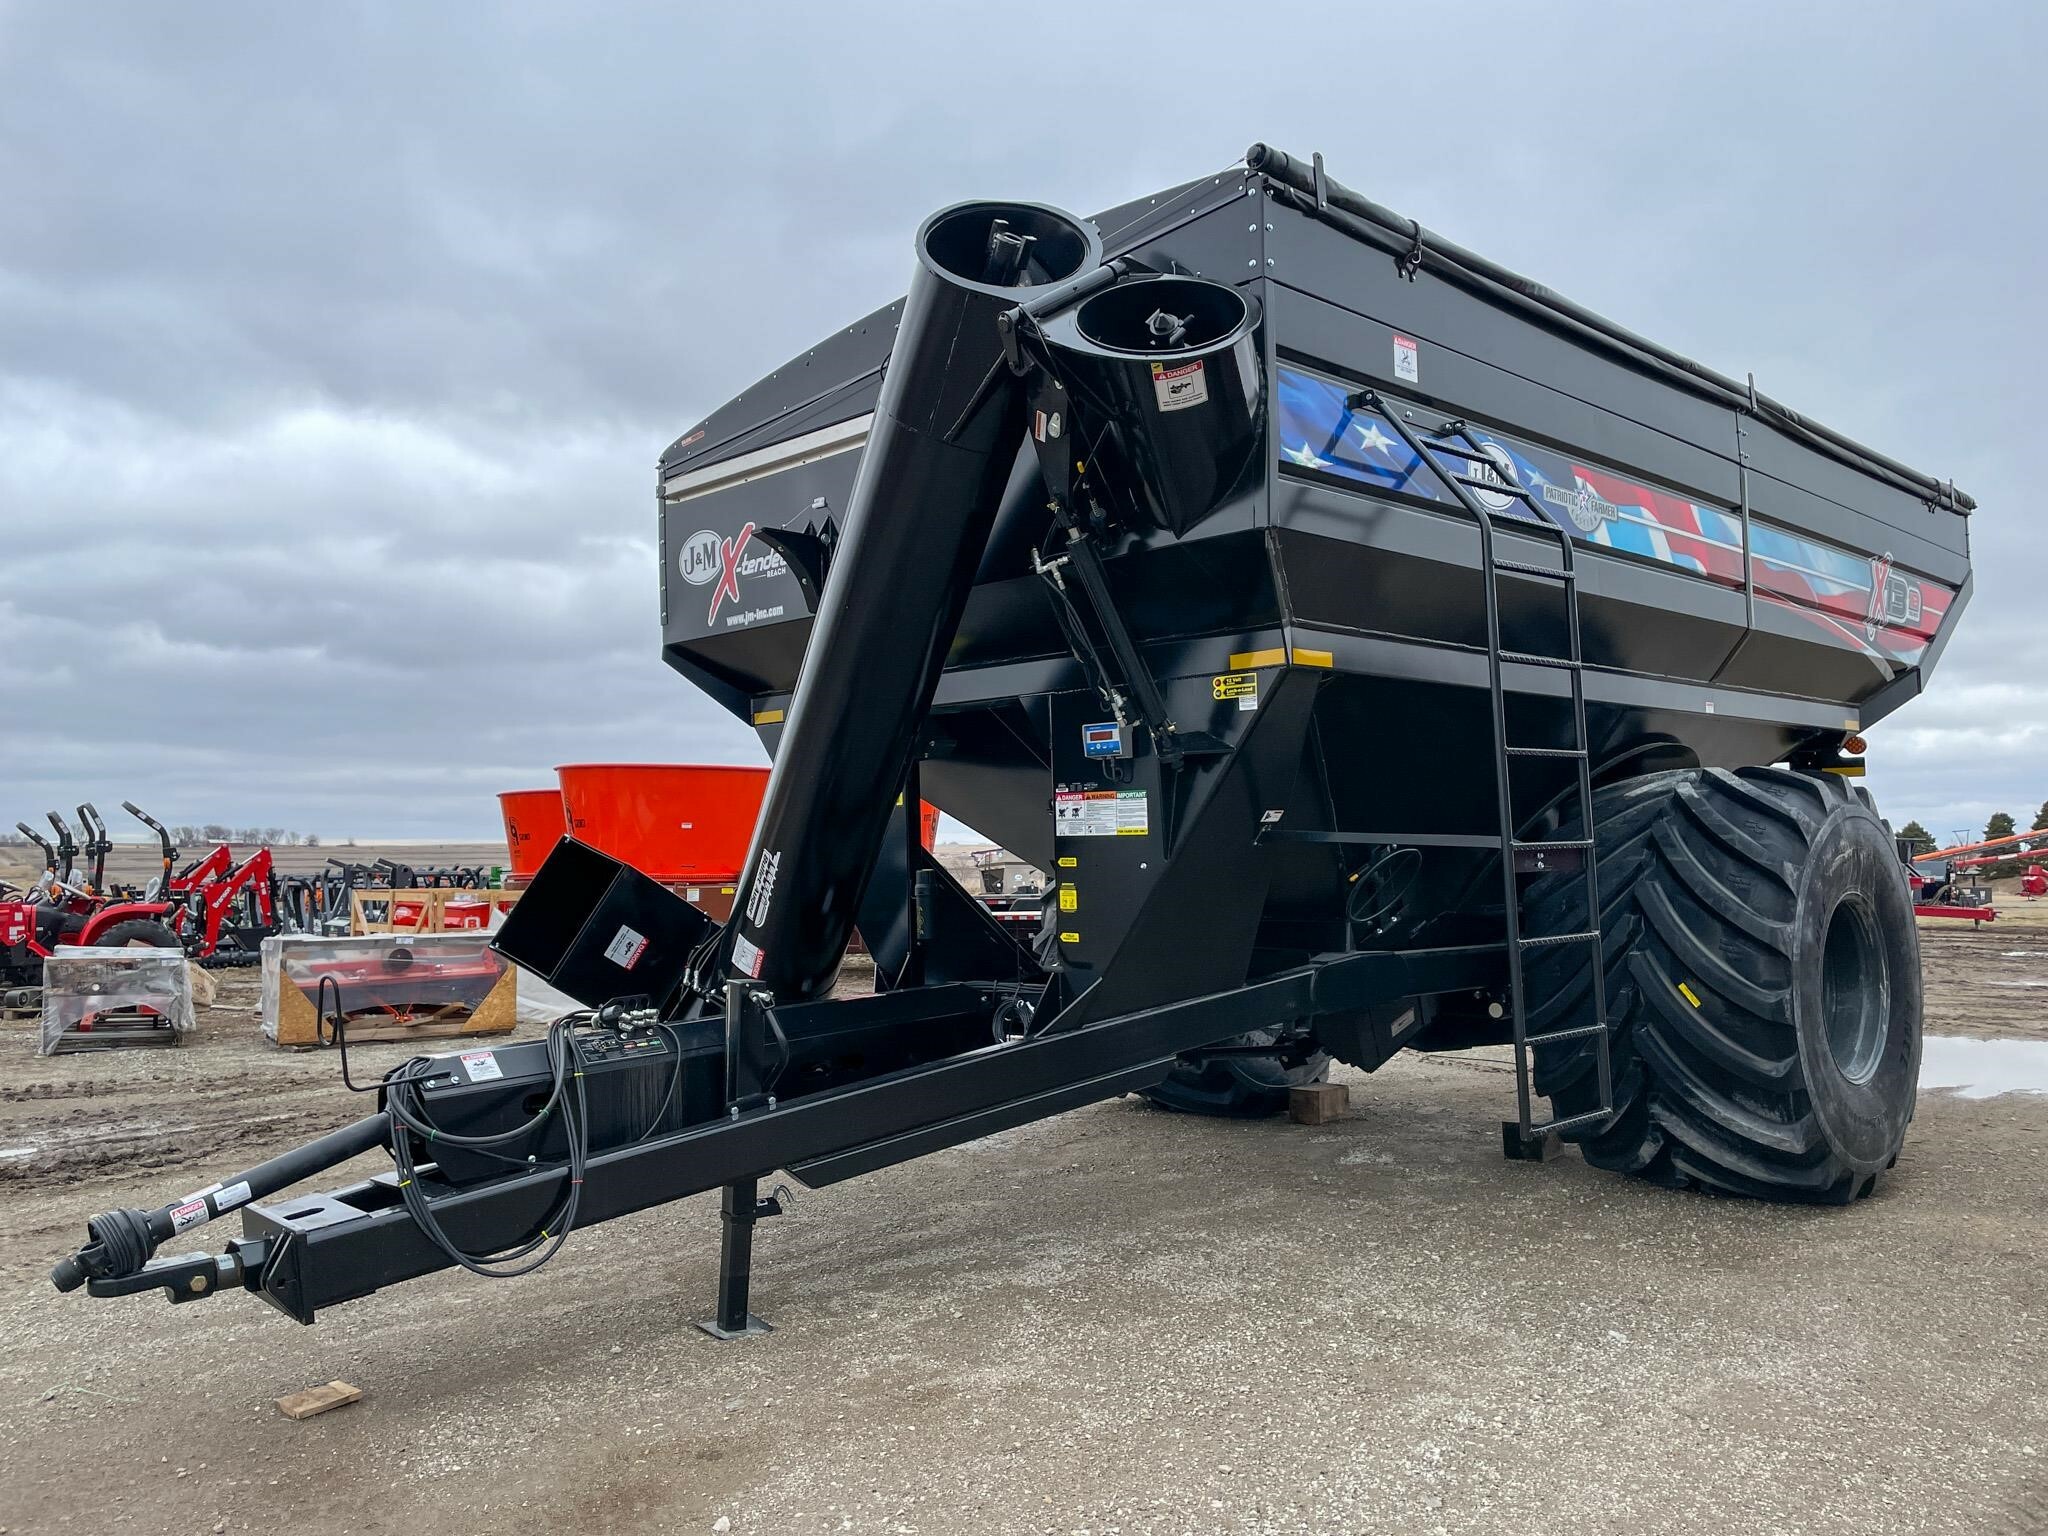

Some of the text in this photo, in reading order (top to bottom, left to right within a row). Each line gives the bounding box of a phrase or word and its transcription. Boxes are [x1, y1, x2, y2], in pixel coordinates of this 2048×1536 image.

[1166, 364, 1199, 378] DANGER
[1545, 486, 1579, 508] PATRIOTIC
[1590, 500, 1617, 518] FARMER
[684, 540, 718, 576] J&M
[766, 567, 787, 578] REACH
[726, 606, 784, 627] www.jm-inc.com
[1117, 791, 1147, 799] IMPORTANT
[626, 944, 646, 970] DANGER
[180, 1200, 204, 1214] DANGER
